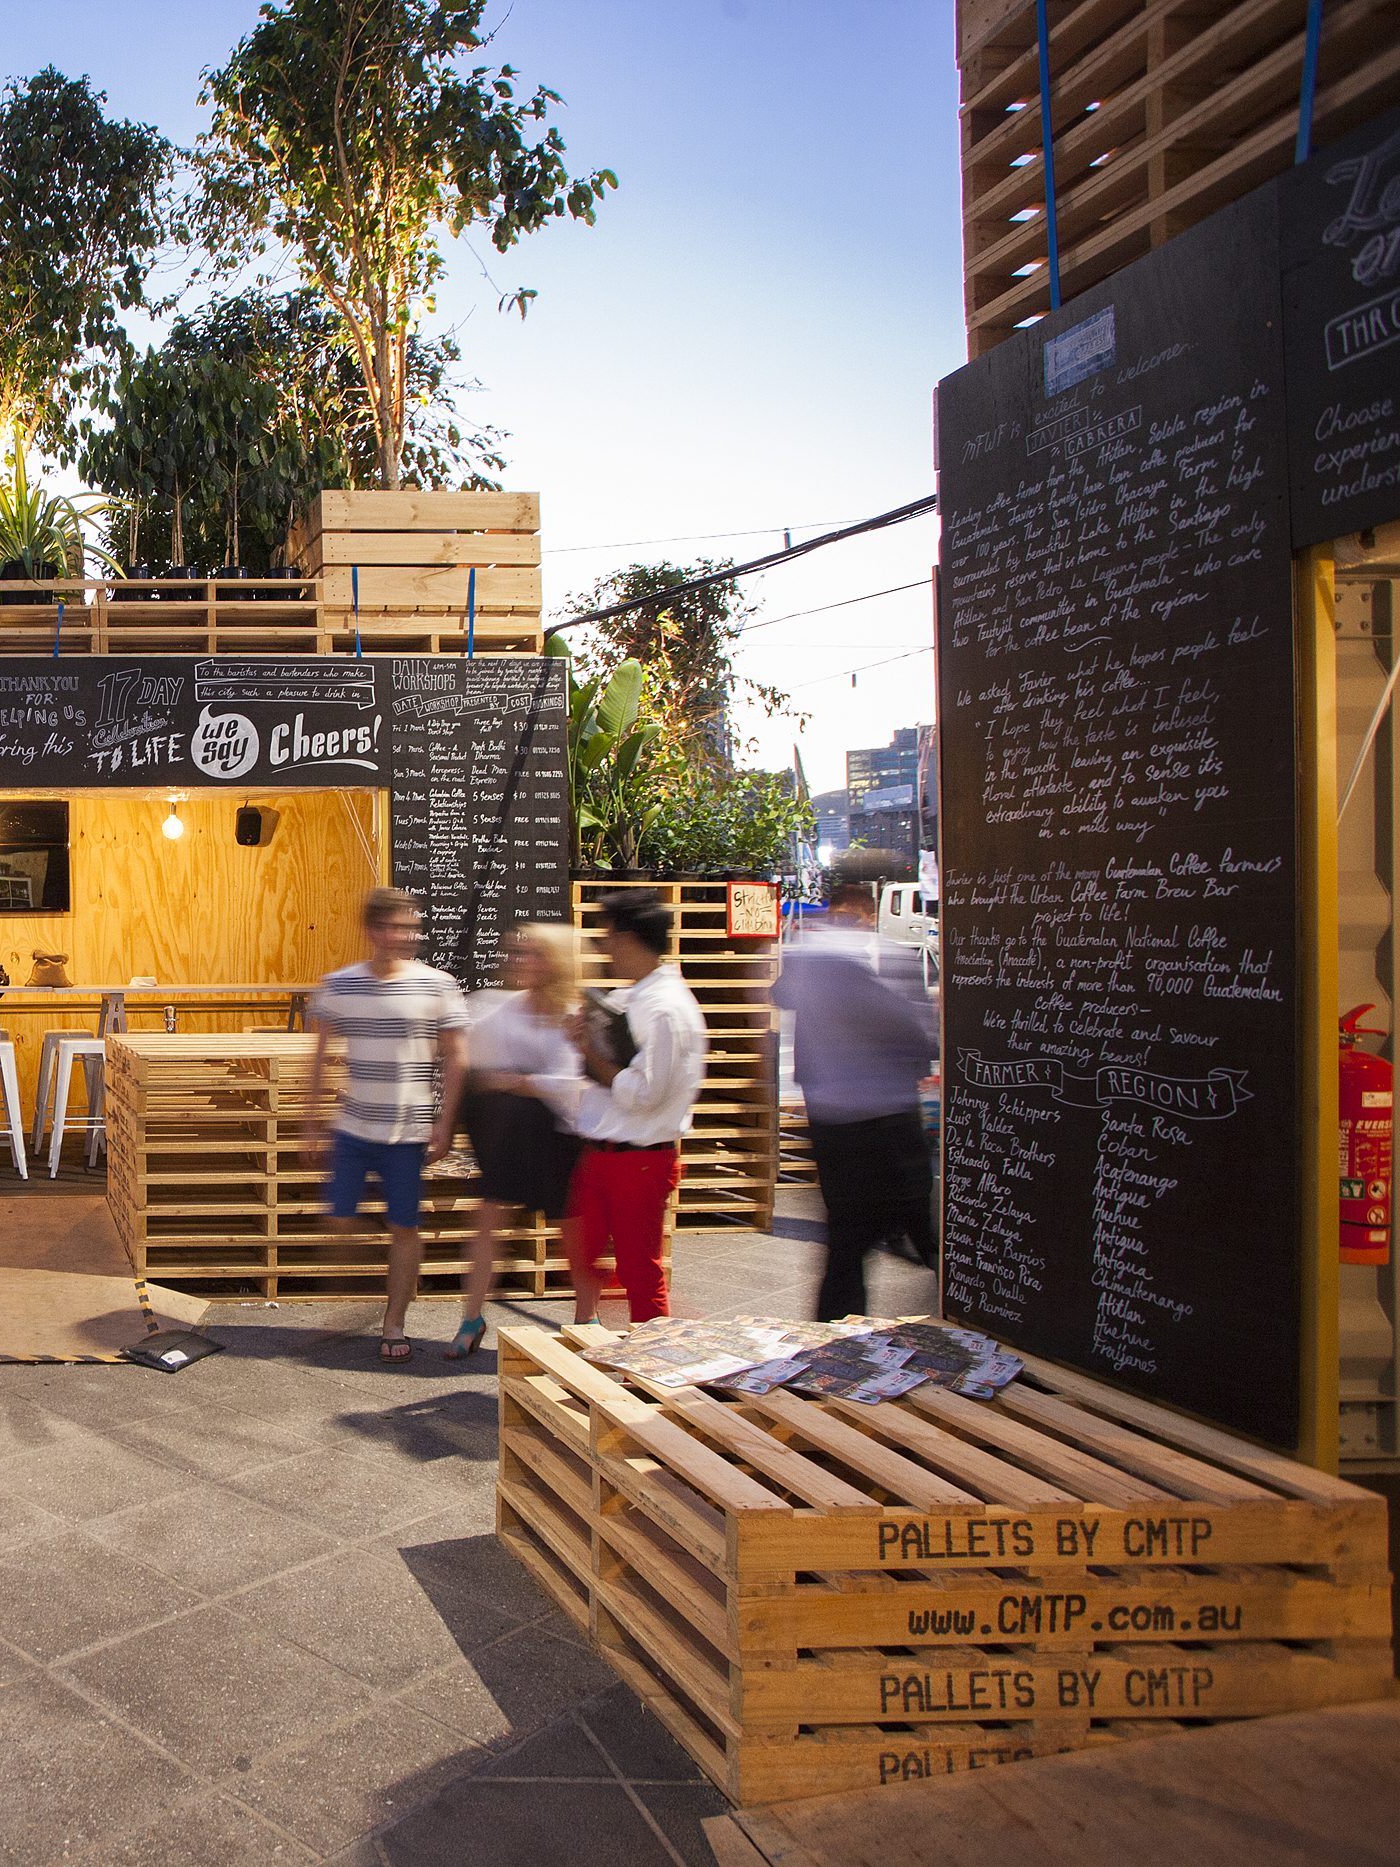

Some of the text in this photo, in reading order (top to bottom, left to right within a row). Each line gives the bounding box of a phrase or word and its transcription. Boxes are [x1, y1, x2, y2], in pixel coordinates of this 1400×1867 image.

[1031, 416, 1082, 450] JAVIER
[1067, 412, 1136, 455] CABRERA
[1315, 398, 1394, 442] Choose
[51, 676, 79, 691] YOU
[200, 668, 366, 678] To the baristas and bartenders who make
[392, 674, 456, 691] WORKSHOPS
[393, 660, 431, 675] DAILY
[26, 693, 54, 705] FOR
[95, 668, 185, 727] 17 DAY
[200, 687, 214, 697] this
[218, 688, 235, 699] city
[277, 687, 309, 698] pleasure
[312, 688, 319, 697] to
[324, 687, 346, 697] drink
[395, 697, 418, 713] DATE
[424, 697, 459, 712] WORKSHOP
[463, 697, 498, 707] PRESENTED
[511, 697, 529, 707] COST
[63, 705, 87, 726] US
[92, 710, 168, 749] Celebration
[42, 732, 74, 757] this
[87, 733, 185, 773] TO LIFE
[270, 713, 382, 765] Cheers!
[948, 893, 966, 907] who
[970, 888, 1008, 913] brought
[1029, 886, 1064, 905] Urban
[1070, 882, 1108, 903] Coffee
[1115, 879, 1150, 900] Farm
[1155, 879, 1197, 900] Brew
[1203, 877, 1239, 900] Bar
[1031, 903, 1130, 929] project to life!
[975, 1062, 1040, 1084] FARMER
[1108, 1071, 1198, 1109] REGION
[946, 1107, 1015, 1136] Luis Valdez
[950, 1085, 1061, 1125] Johnny Schippers
[1101, 1110, 1193, 1146] Santa Rosa
[946, 1126, 1056, 1167] De la Roca Brothers
[1097, 1134, 1158, 1162] Coban
[1092, 1177, 1151, 1209] Antigua
[1093, 1155, 1178, 1198] Acatenango
[1092, 1199, 1143, 1228] Huehue
[879, 1519, 1212, 1559] PALLETS BY CMTP
[908, 1595, 1242, 1635] www.CMTP.com.au
[880, 1668, 1214, 1714] PALLETS BY CMTP
